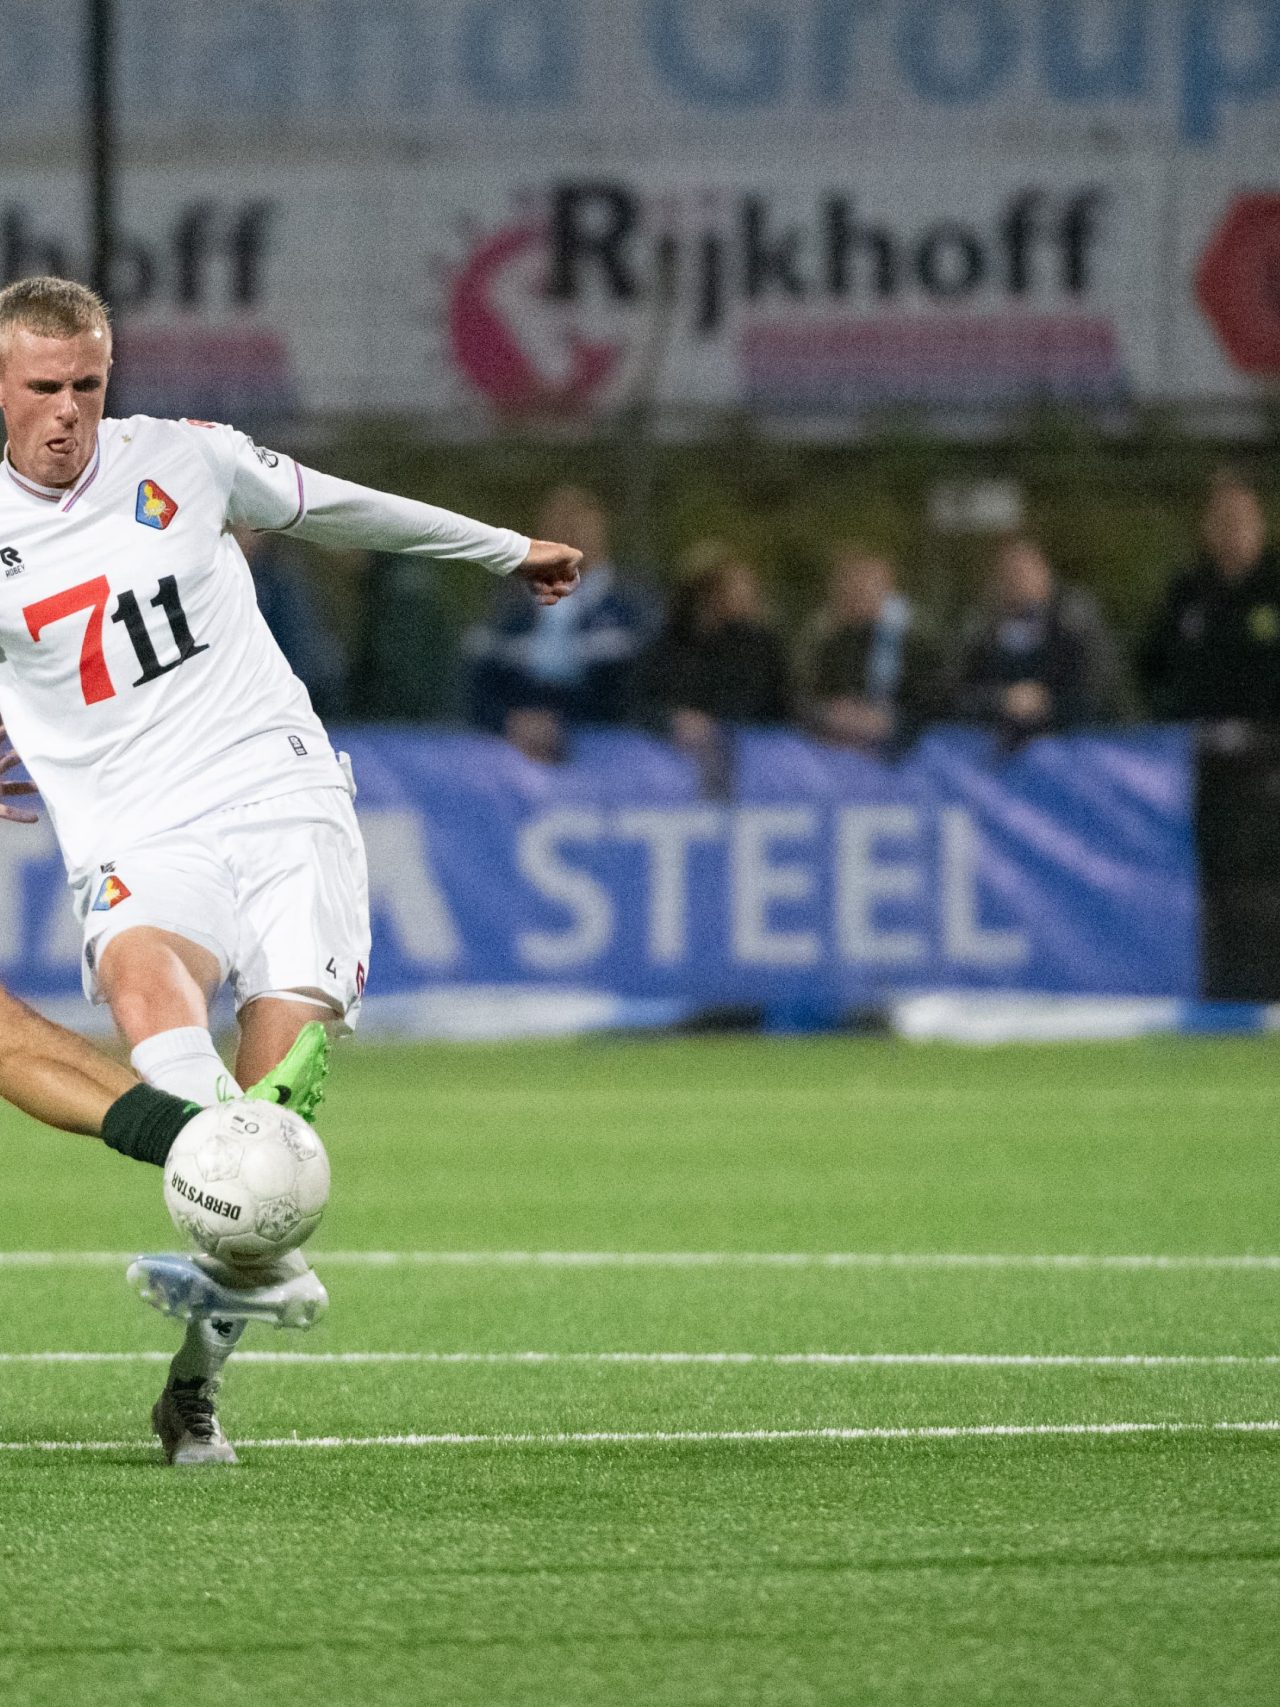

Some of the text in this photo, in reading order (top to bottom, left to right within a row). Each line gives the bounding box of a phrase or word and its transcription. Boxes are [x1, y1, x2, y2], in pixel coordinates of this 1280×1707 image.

[647, 0, 1280, 145] Group
[546, 182, 1107, 336] Rijkhoff
[520, 806, 1030, 967] STEEL
[171, 1171, 242, 1220] DERBYSTAR
